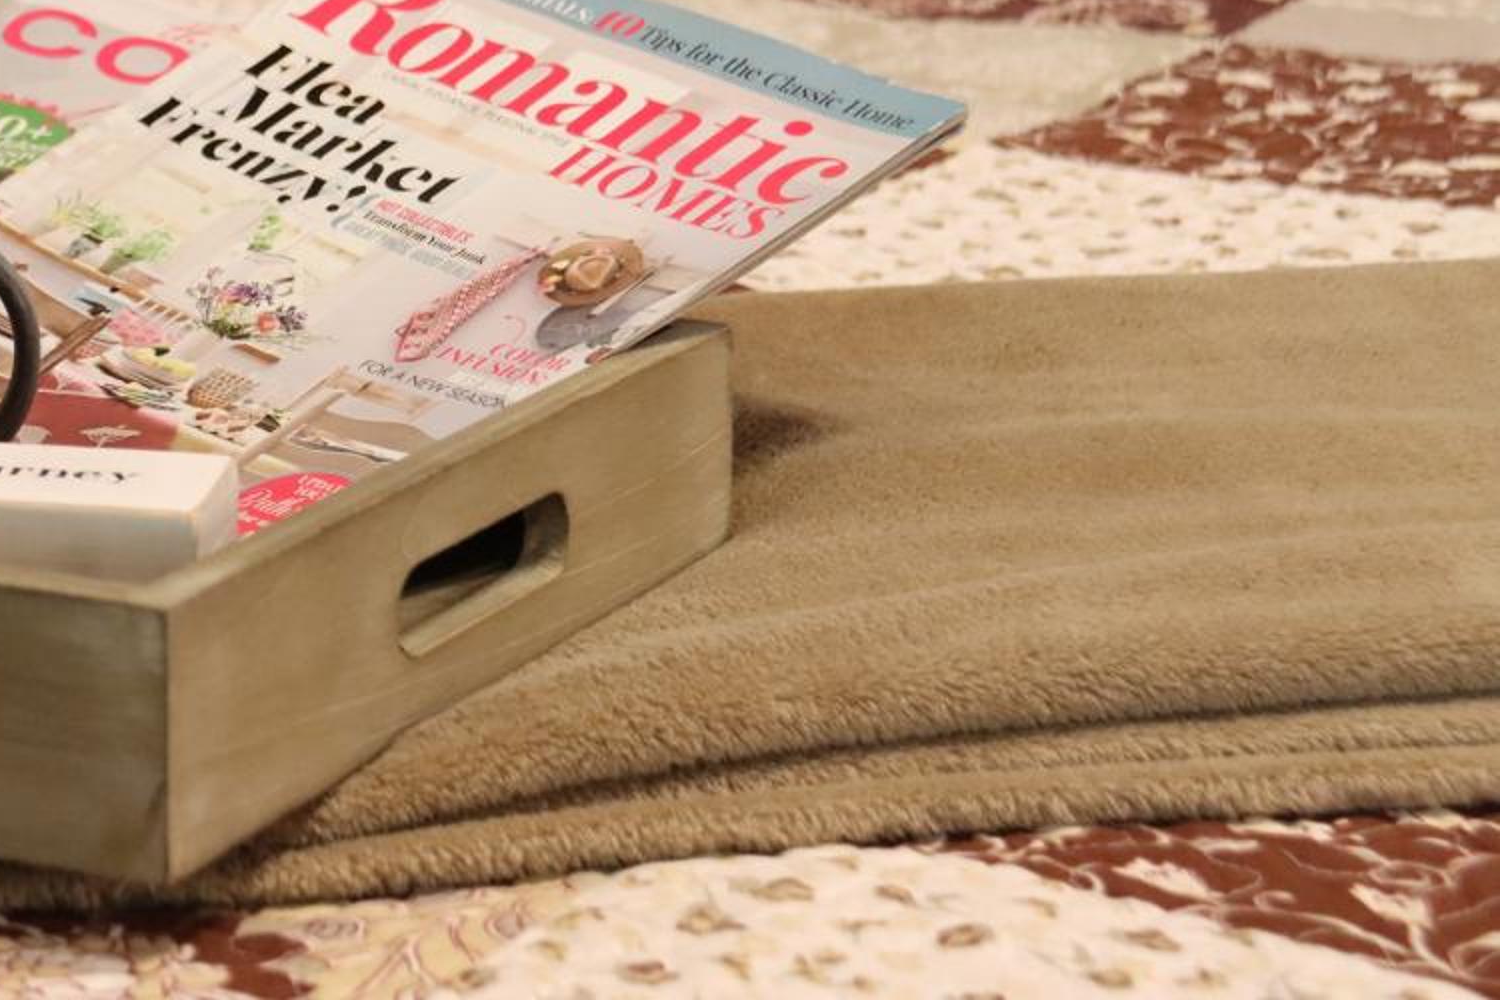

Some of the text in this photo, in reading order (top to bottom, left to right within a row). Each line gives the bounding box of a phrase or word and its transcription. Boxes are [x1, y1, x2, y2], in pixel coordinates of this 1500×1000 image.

[242, 43, 387, 127] Flea
[638, 24, 686, 56] Tips
[685, 41, 726, 68] for
[722, 52, 764, 83] the
[762, 71, 845, 111] Classic
[841, 99, 916, 132] Home
[136, 96, 370, 213] Frenzy!
[214, 85, 463, 205] Market
[549, 145, 786, 240] HOMES
[356, 359, 394, 378] FOR
[403, 375, 450, 395] NEW
